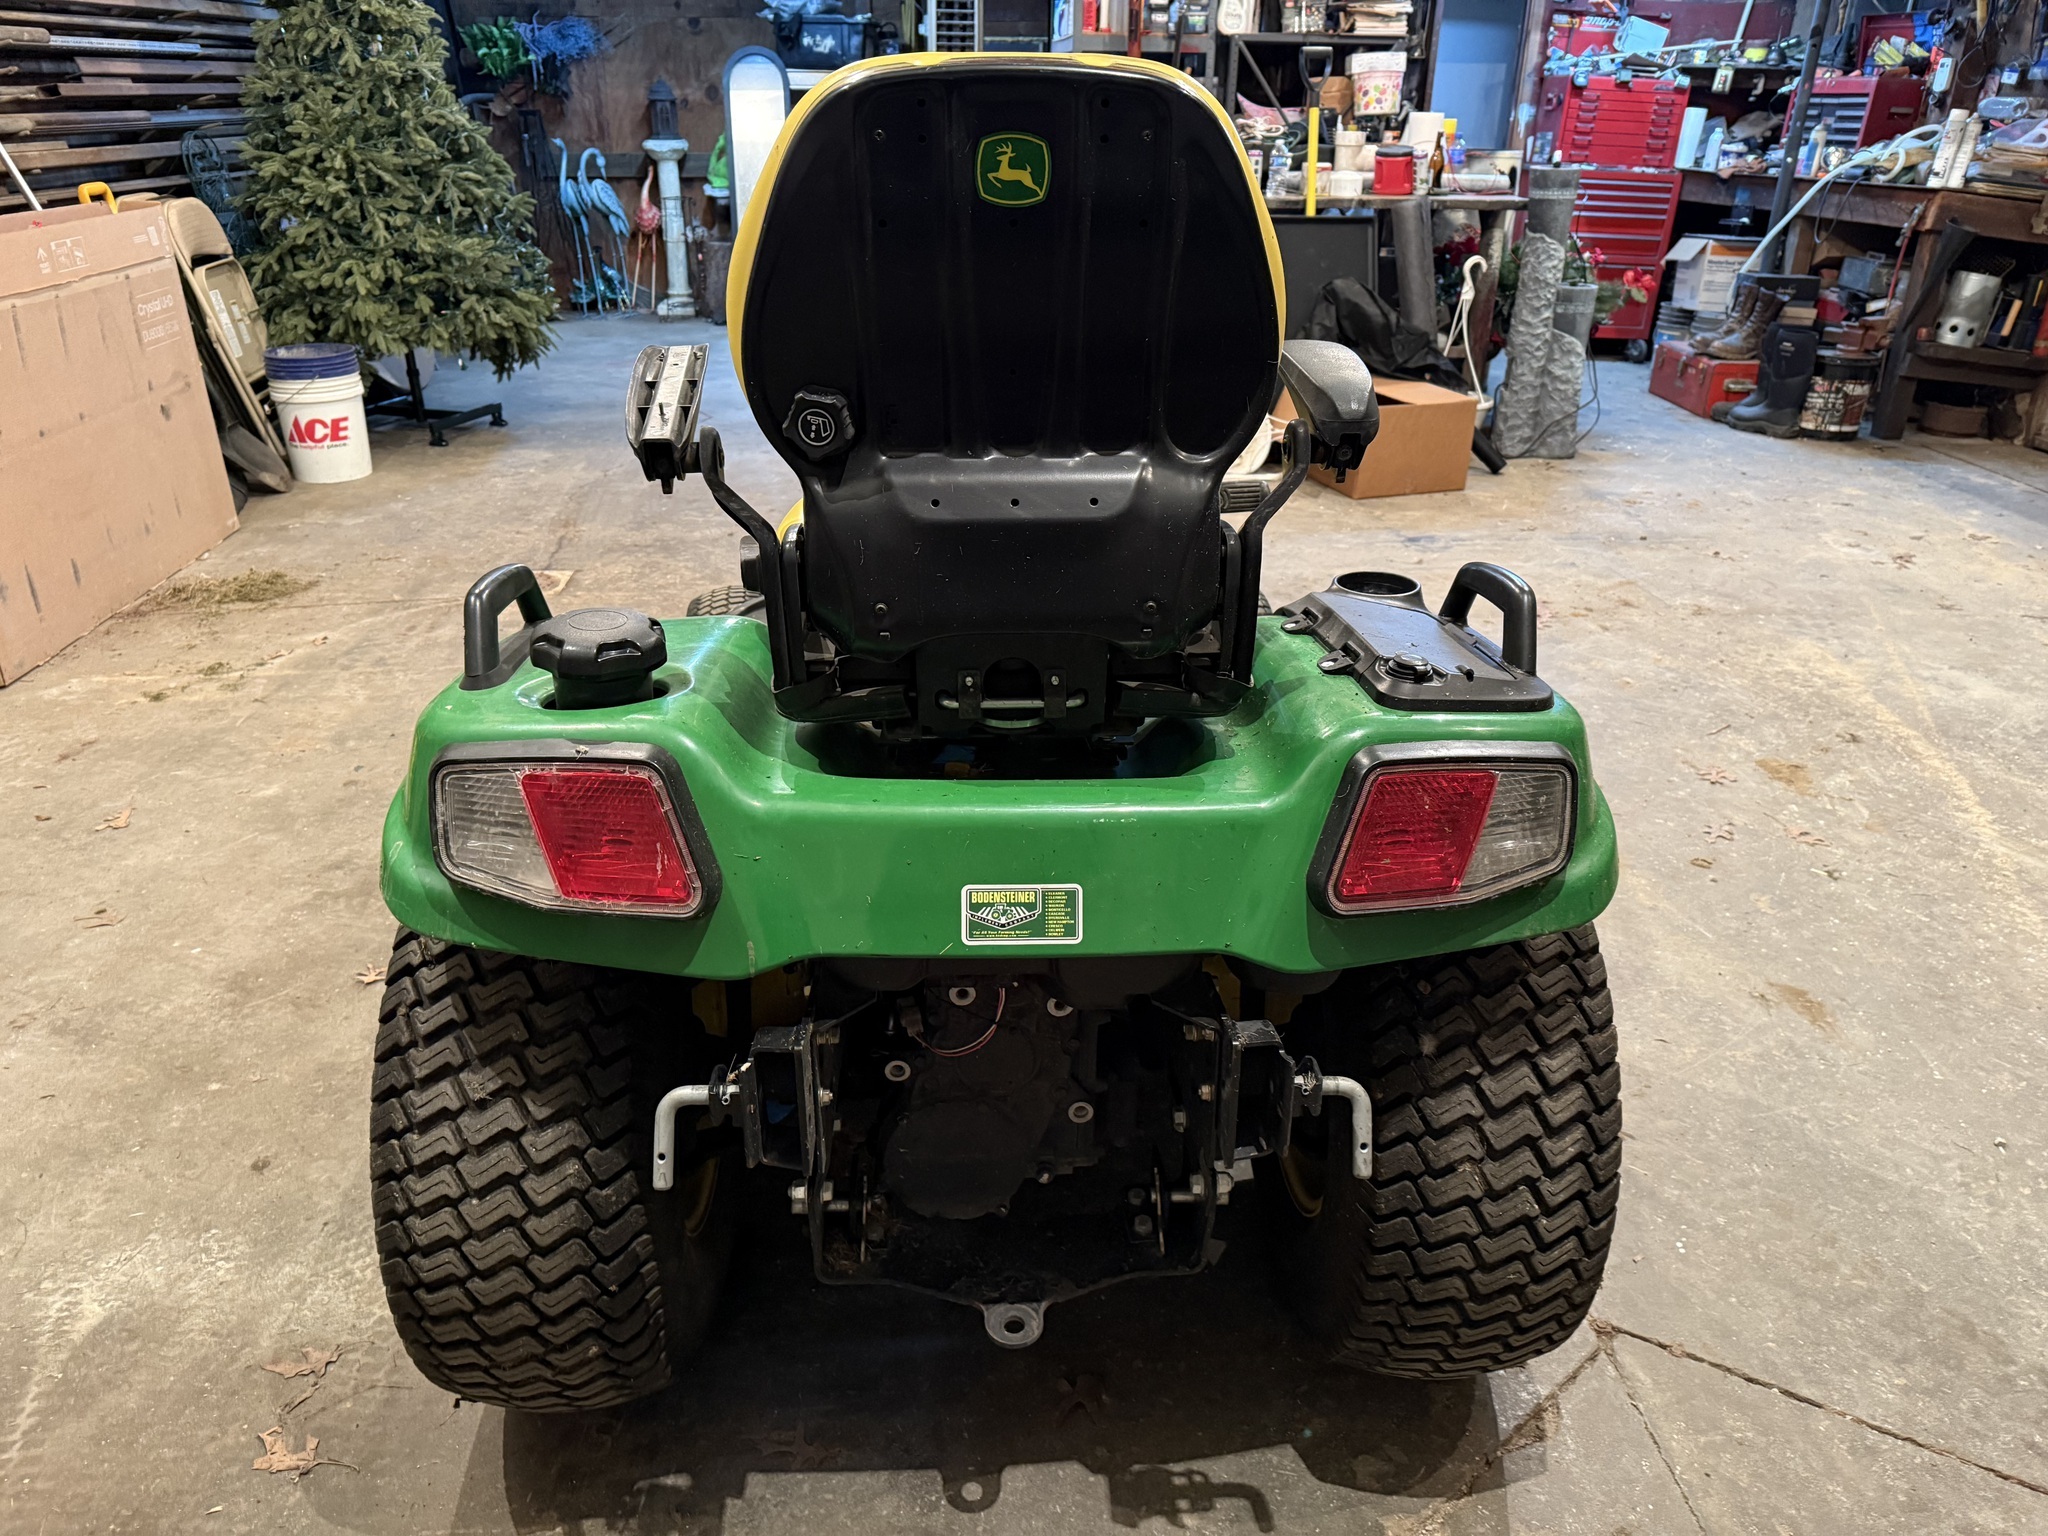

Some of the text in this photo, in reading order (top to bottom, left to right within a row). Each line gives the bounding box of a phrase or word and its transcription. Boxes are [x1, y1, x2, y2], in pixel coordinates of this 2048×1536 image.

[137, 297, 162, 318] Crystal
[289, 414, 349, 444] ACE
[326, 442, 350, 450] place.
[972, 892, 1035, 903] BODENSTEINER
[972, 914, 1034, 926] IMPLEMENT COMPANY
